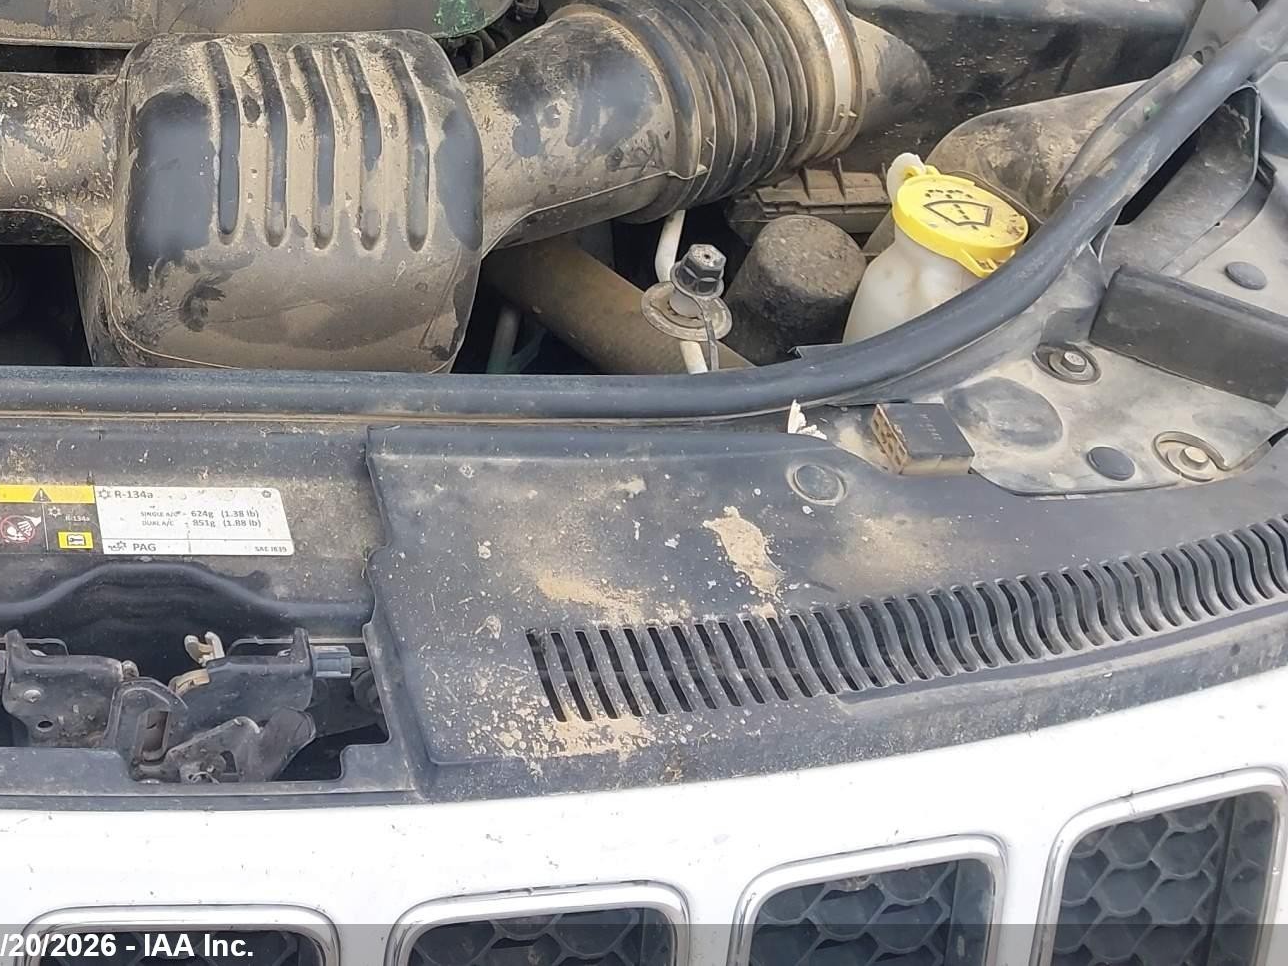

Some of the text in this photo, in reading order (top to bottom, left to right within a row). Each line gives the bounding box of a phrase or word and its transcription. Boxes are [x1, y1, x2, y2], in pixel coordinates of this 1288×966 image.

[114, 490, 154, 499] R-134a
[190, 510, 214, 519] 624g
[221, 509, 245, 518] (1.38
[246, 509, 259, 518] lb)
[192, 519, 216, 528] 851g
[223, 519, 247, 527] (1.88
[248, 519, 262, 528] lb)
[132, 543, 157, 552] PAG
